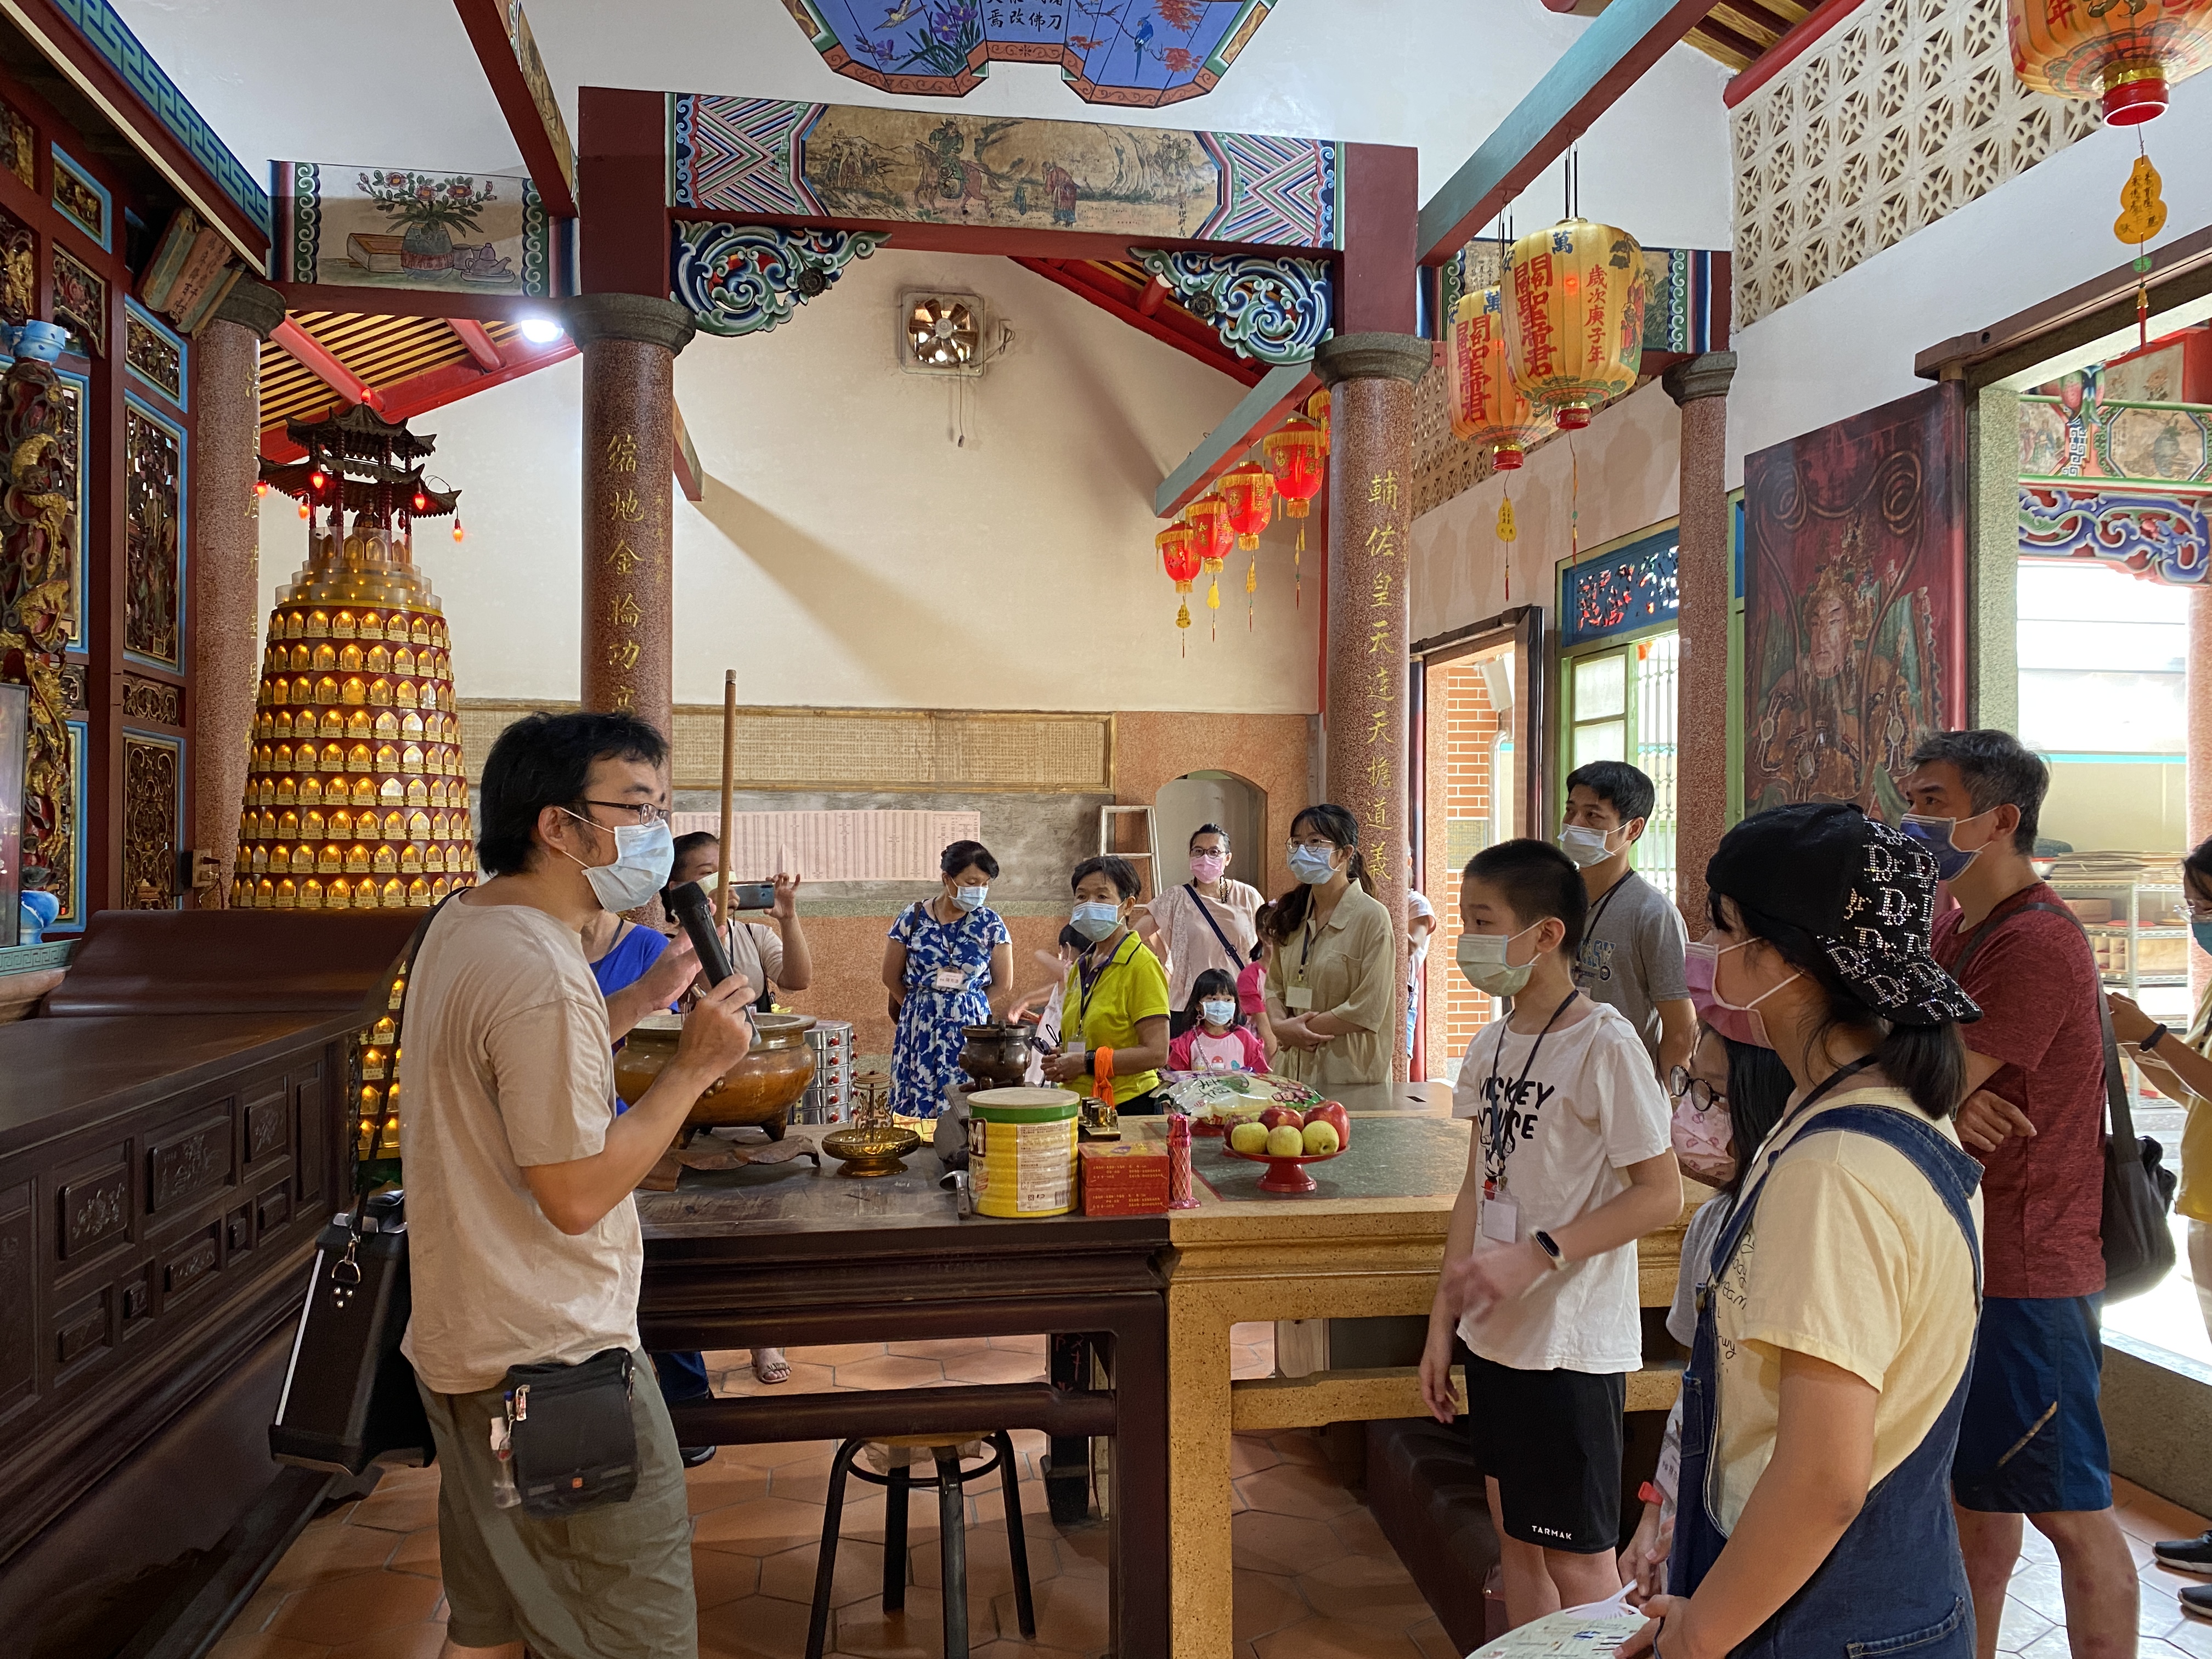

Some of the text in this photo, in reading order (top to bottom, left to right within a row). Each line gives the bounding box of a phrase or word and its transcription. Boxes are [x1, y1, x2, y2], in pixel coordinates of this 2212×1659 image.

[1584, 264, 1608, 367] 歲次庚子年
[1532, 1525, 1572, 1540] TARMAK
